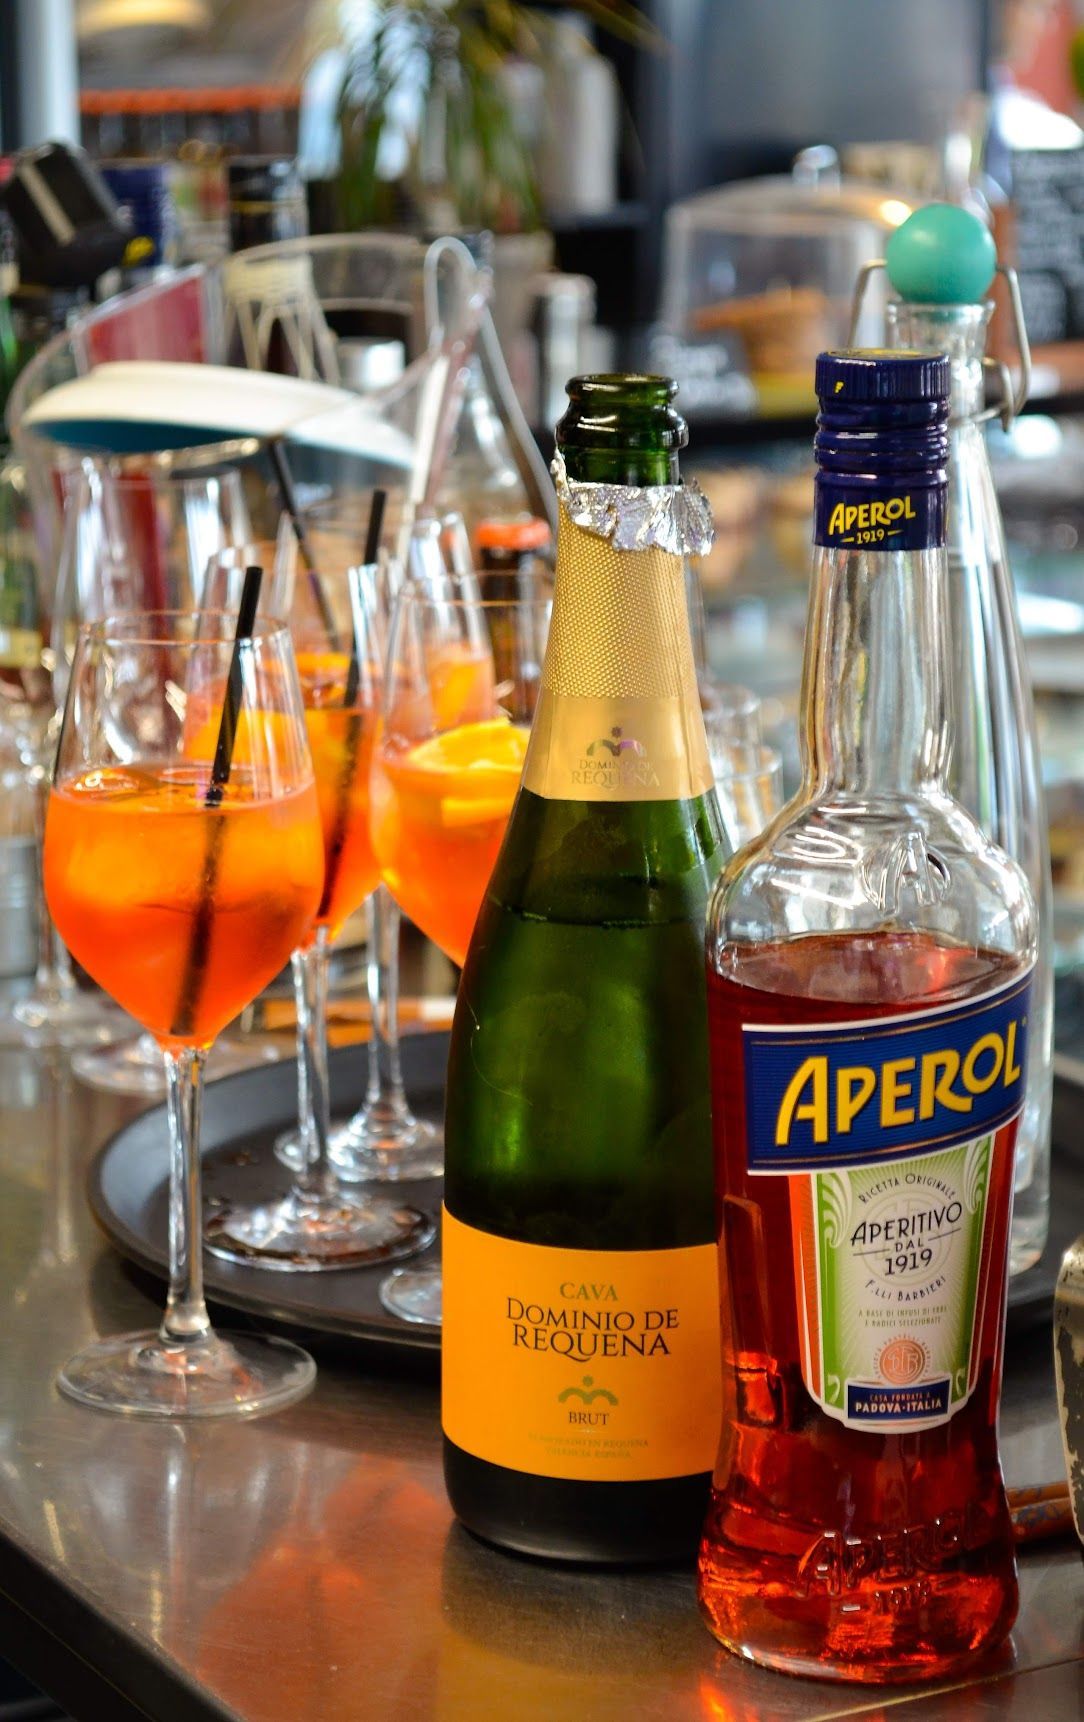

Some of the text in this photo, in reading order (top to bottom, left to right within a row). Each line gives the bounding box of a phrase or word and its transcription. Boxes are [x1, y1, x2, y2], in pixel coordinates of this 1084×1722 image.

[827, 495, 917, 536] APEROL
[856, 528, 885, 545] 1919
[571, 771, 661, 789] REQUNA
[774, 1020, 1022, 1147] APEROL
[858, 1172, 957, 1204] RICETTA ORIGINALE
[850, 1201, 963, 1247] APERITIVO
[894, 1238, 924, 1253] DAL
[884, 1248, 933, 1276] 1919
[559, 1281, 619, 1301] CAVA
[897, 1275, 947, 1301] BARBIERI
[506, 1296, 680, 1332] DOMINIO DE
[512, 1323, 671, 1363] REQUENA
[568, 1411, 610, 1426] BRUT
